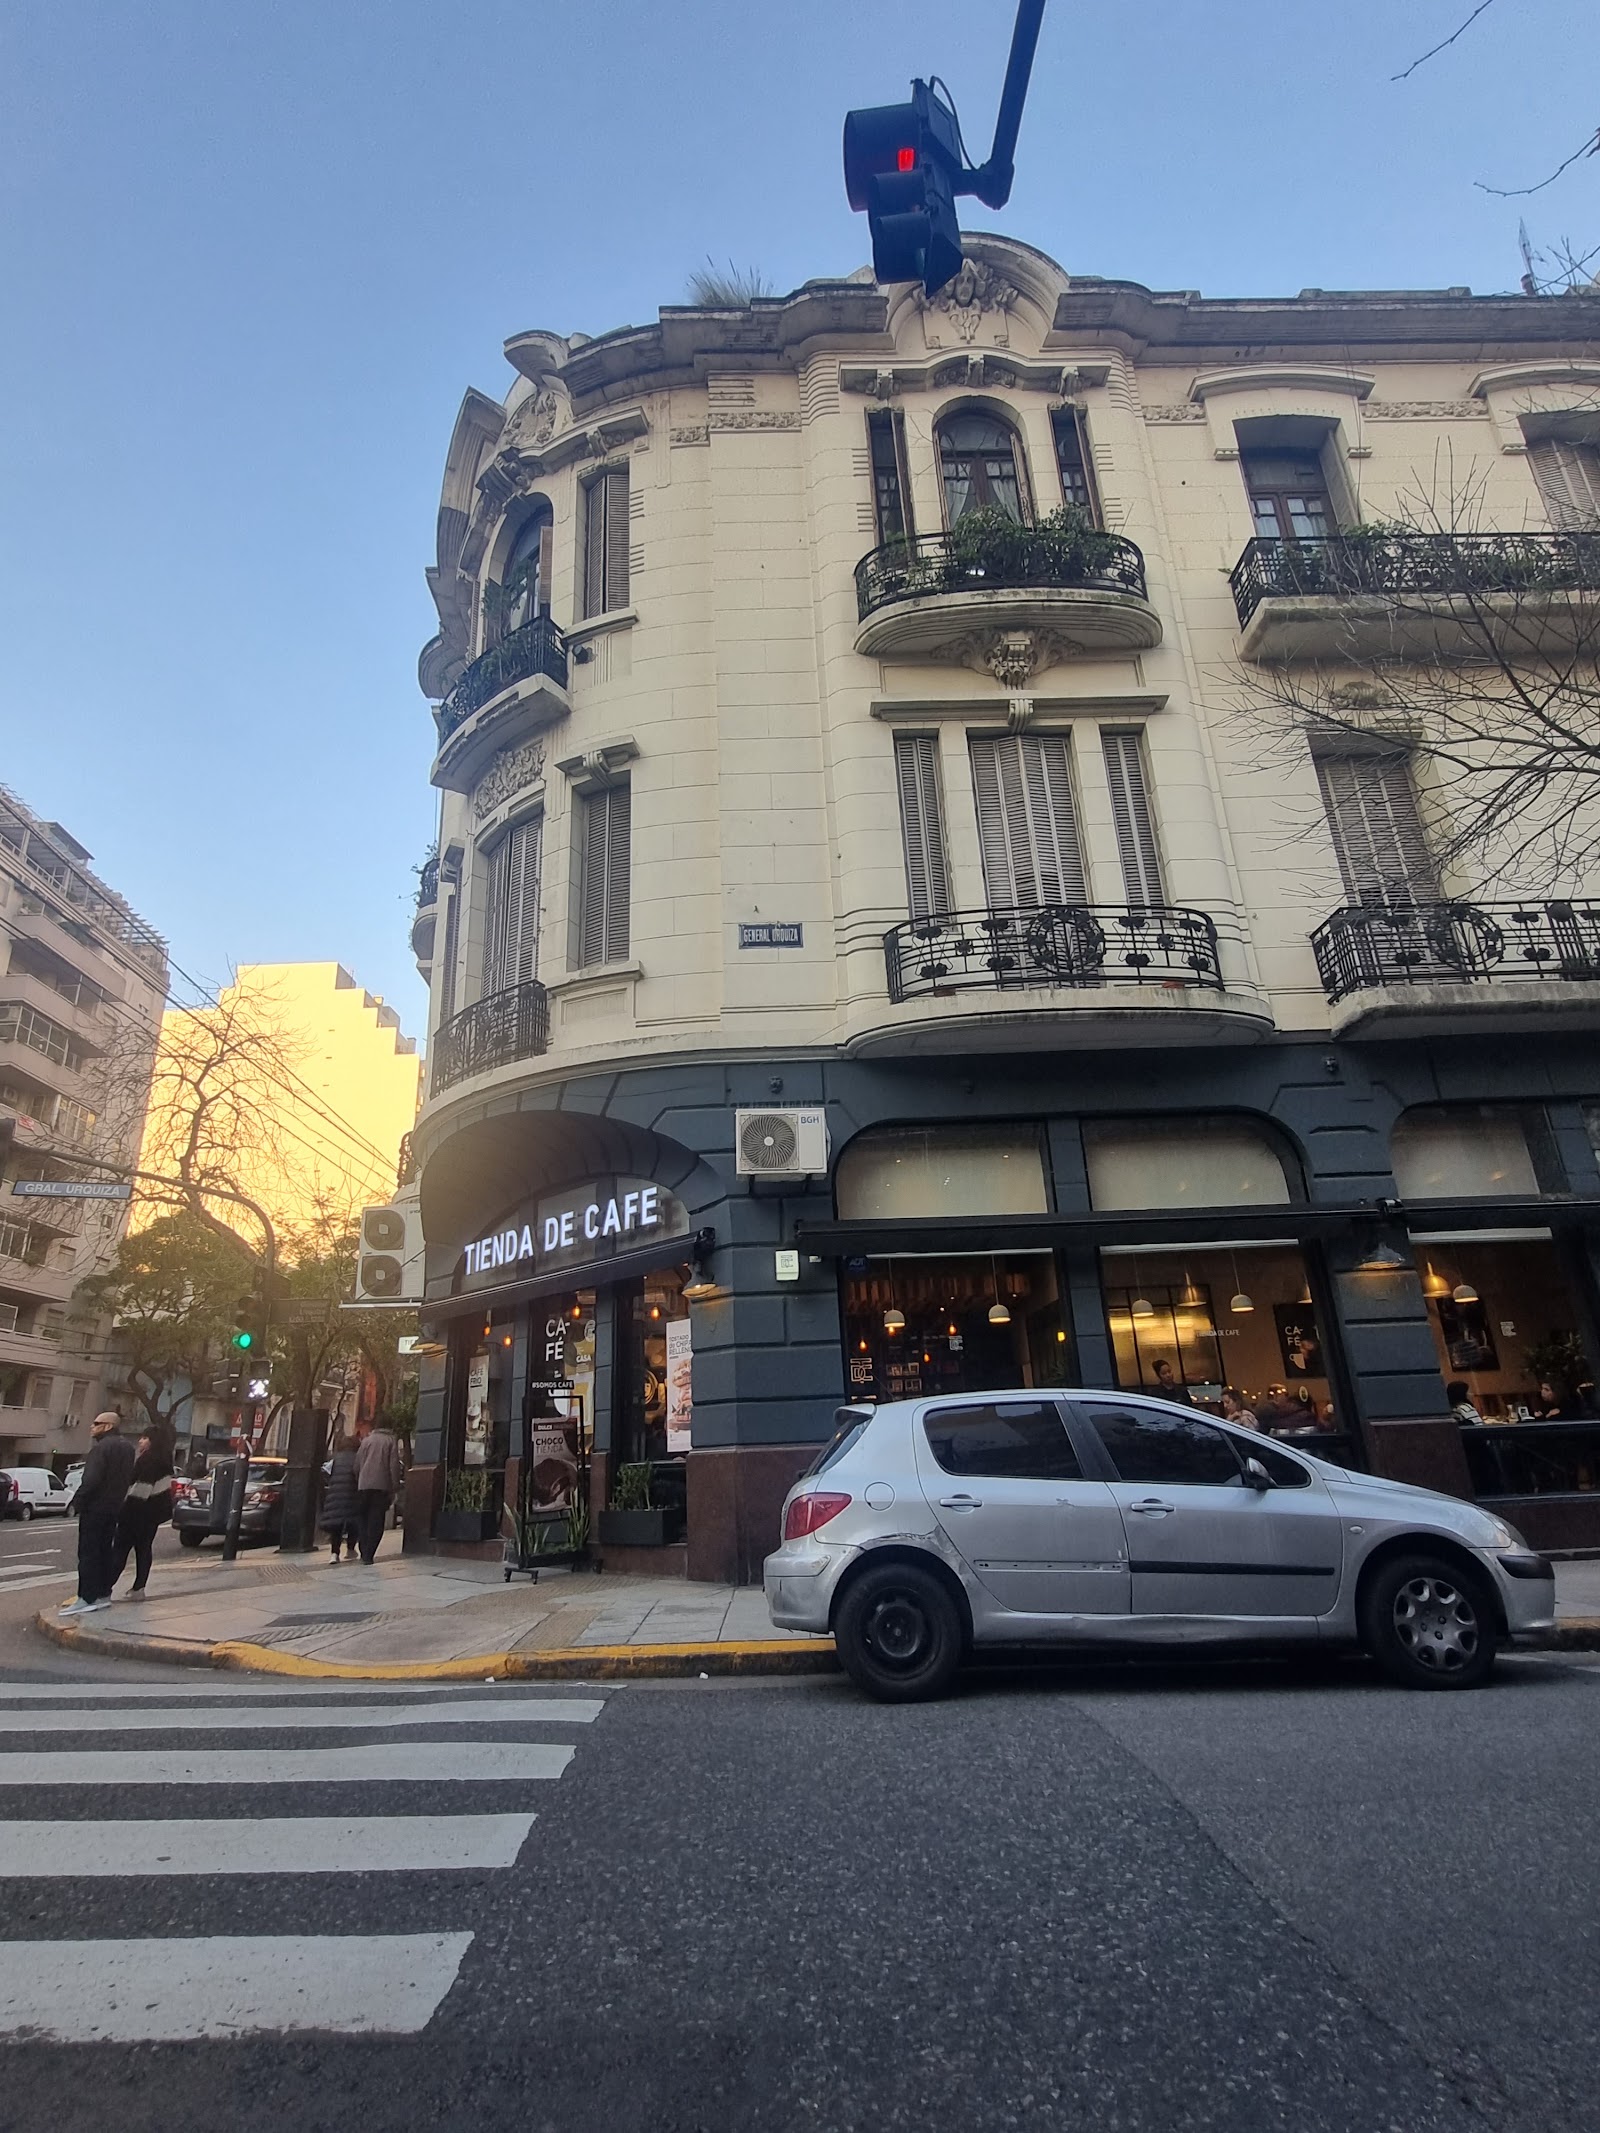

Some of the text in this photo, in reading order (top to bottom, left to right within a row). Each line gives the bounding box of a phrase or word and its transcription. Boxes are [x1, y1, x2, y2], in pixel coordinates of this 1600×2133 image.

[743, 928, 799, 942] GENERAL URQUIZA
[800, 1116, 820, 1124] BGH
[66, 1185, 120, 1196] URQUIZA
[464, 1187, 658, 1276] TIENDA DE CAFE
[546, 1337, 564, 1361] FÉ
[576, 1354, 592, 1363] CASA
[536, 1437, 564, 1445] CHOCO
[536, 1445, 564, 1454] TIENDA
